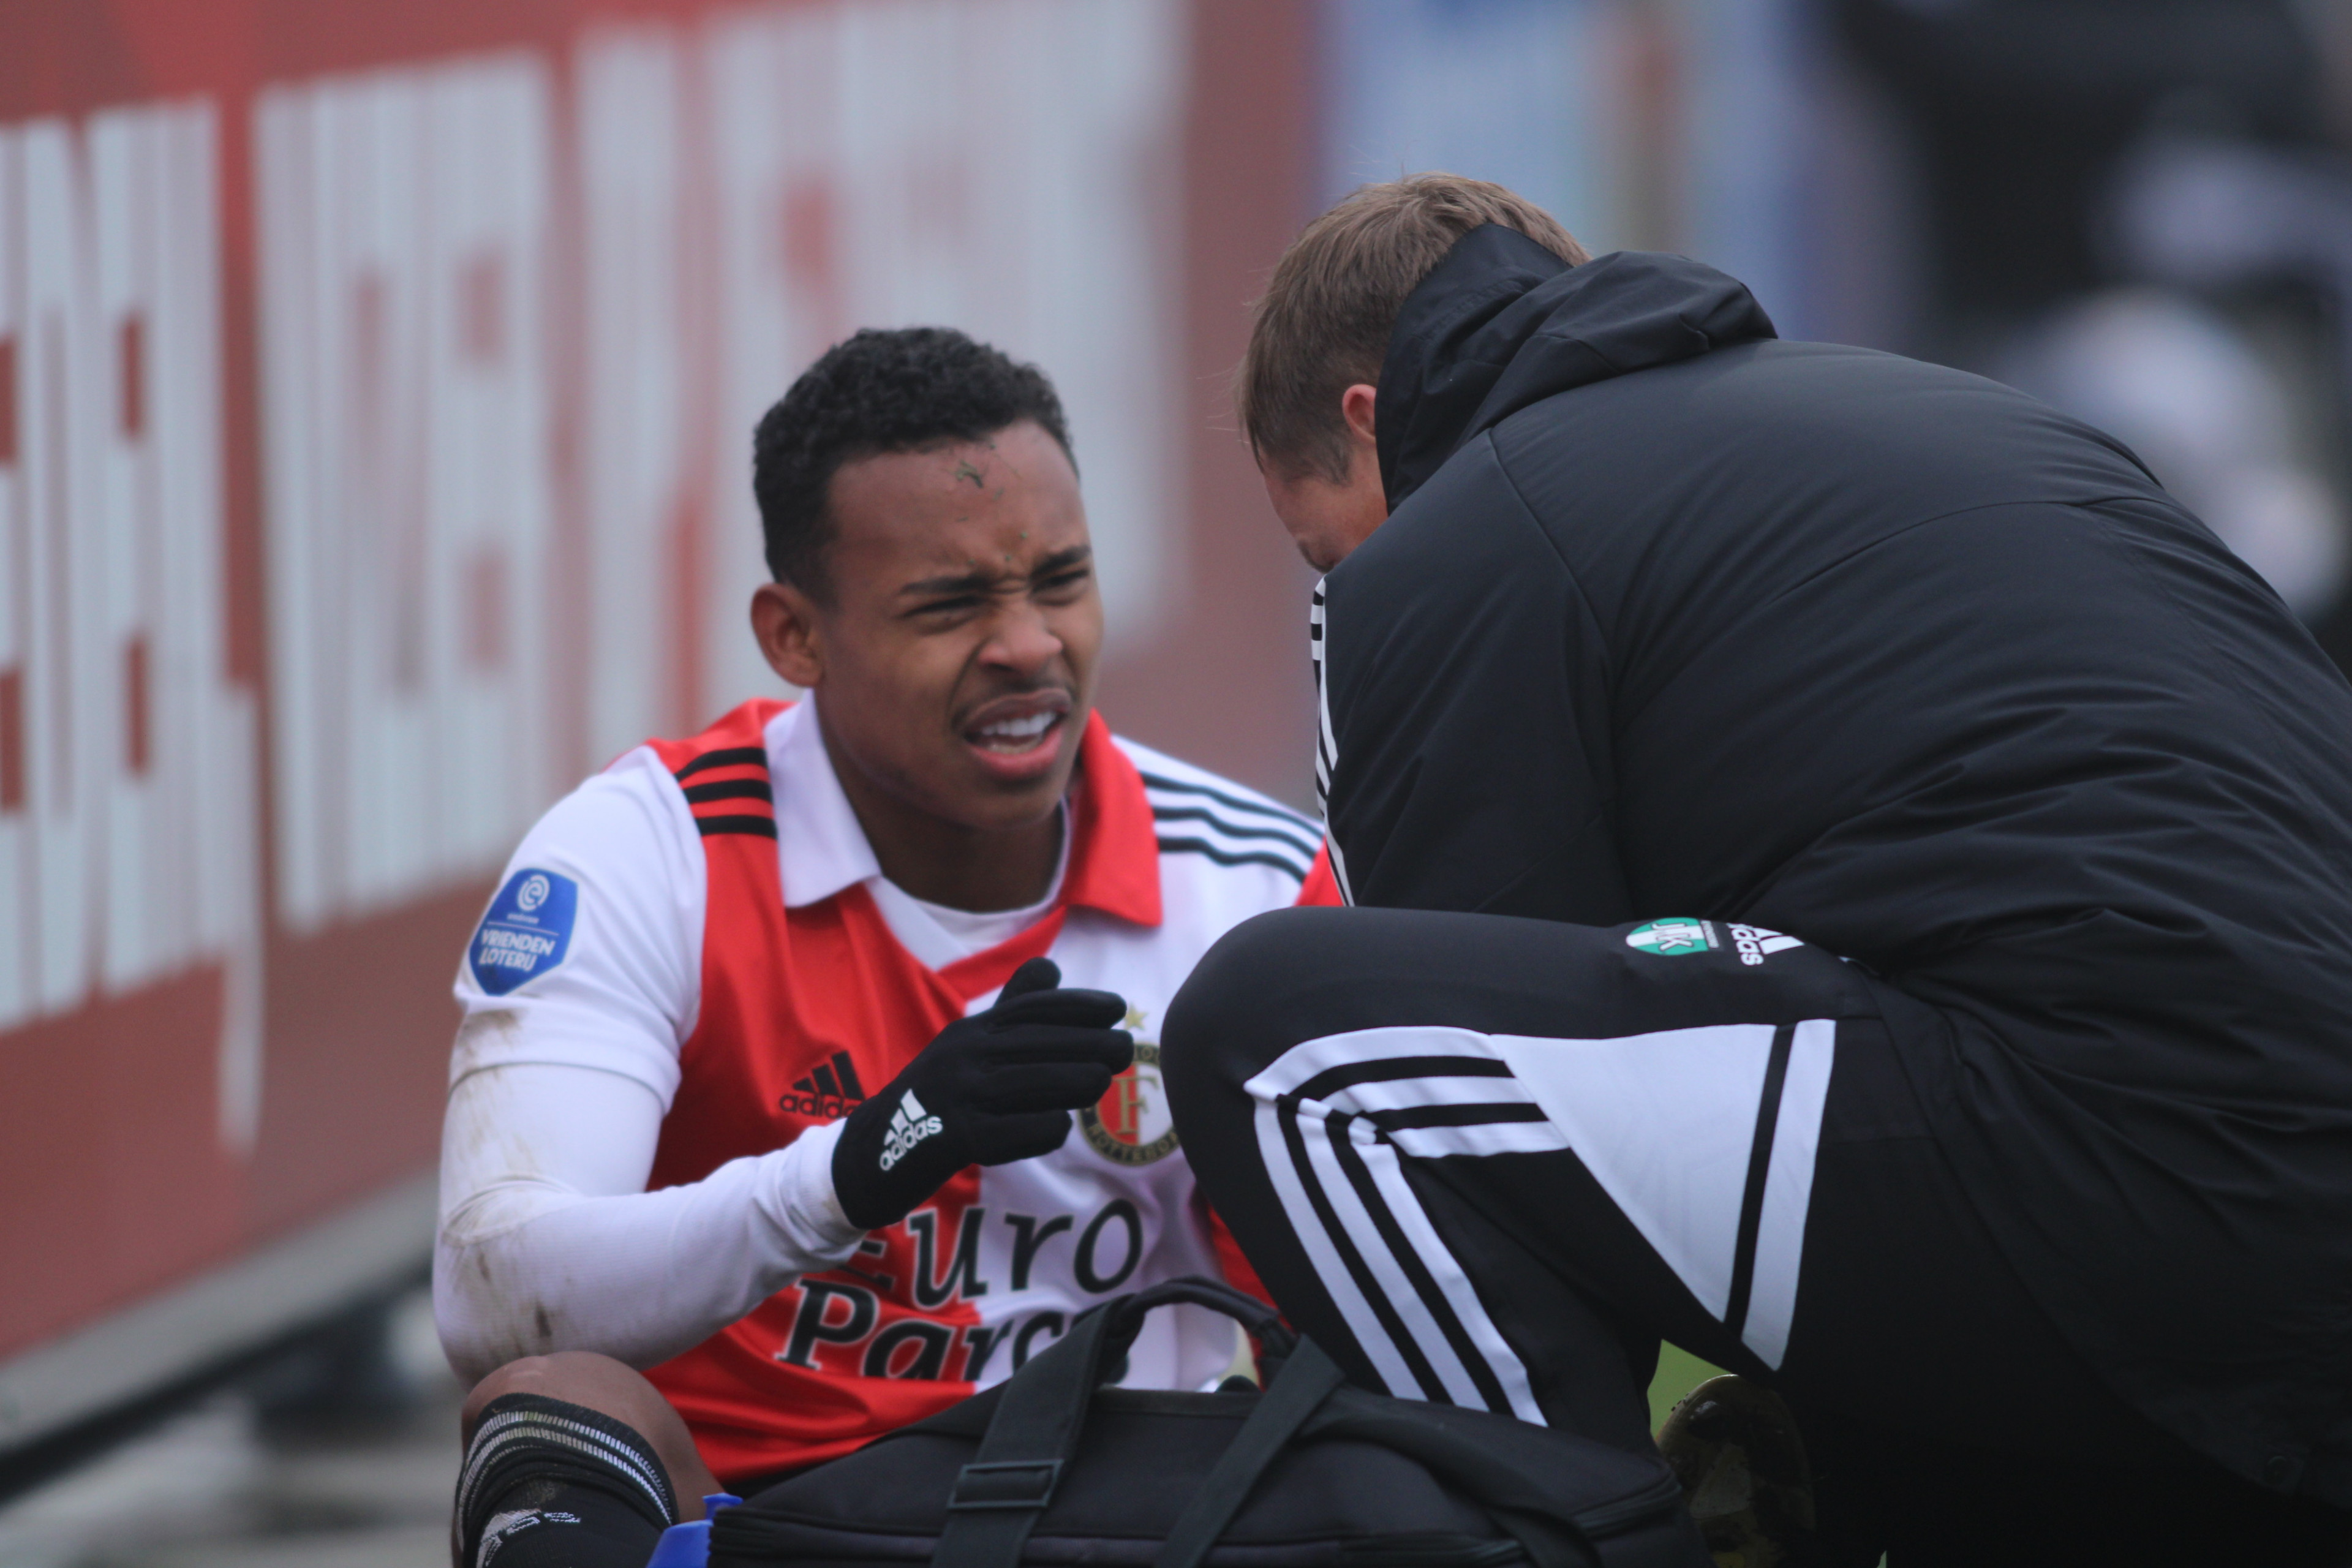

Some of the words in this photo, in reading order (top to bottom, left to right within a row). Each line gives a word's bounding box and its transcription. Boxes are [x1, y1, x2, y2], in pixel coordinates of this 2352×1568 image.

[481, 929, 556, 956] VRIENDEN
[778, 1093, 856, 1119] adid
[1112, 1076, 1159, 1134] F
[880, 1116, 943, 1171] adidas
[774, 1277, 1129, 1385] Parc
